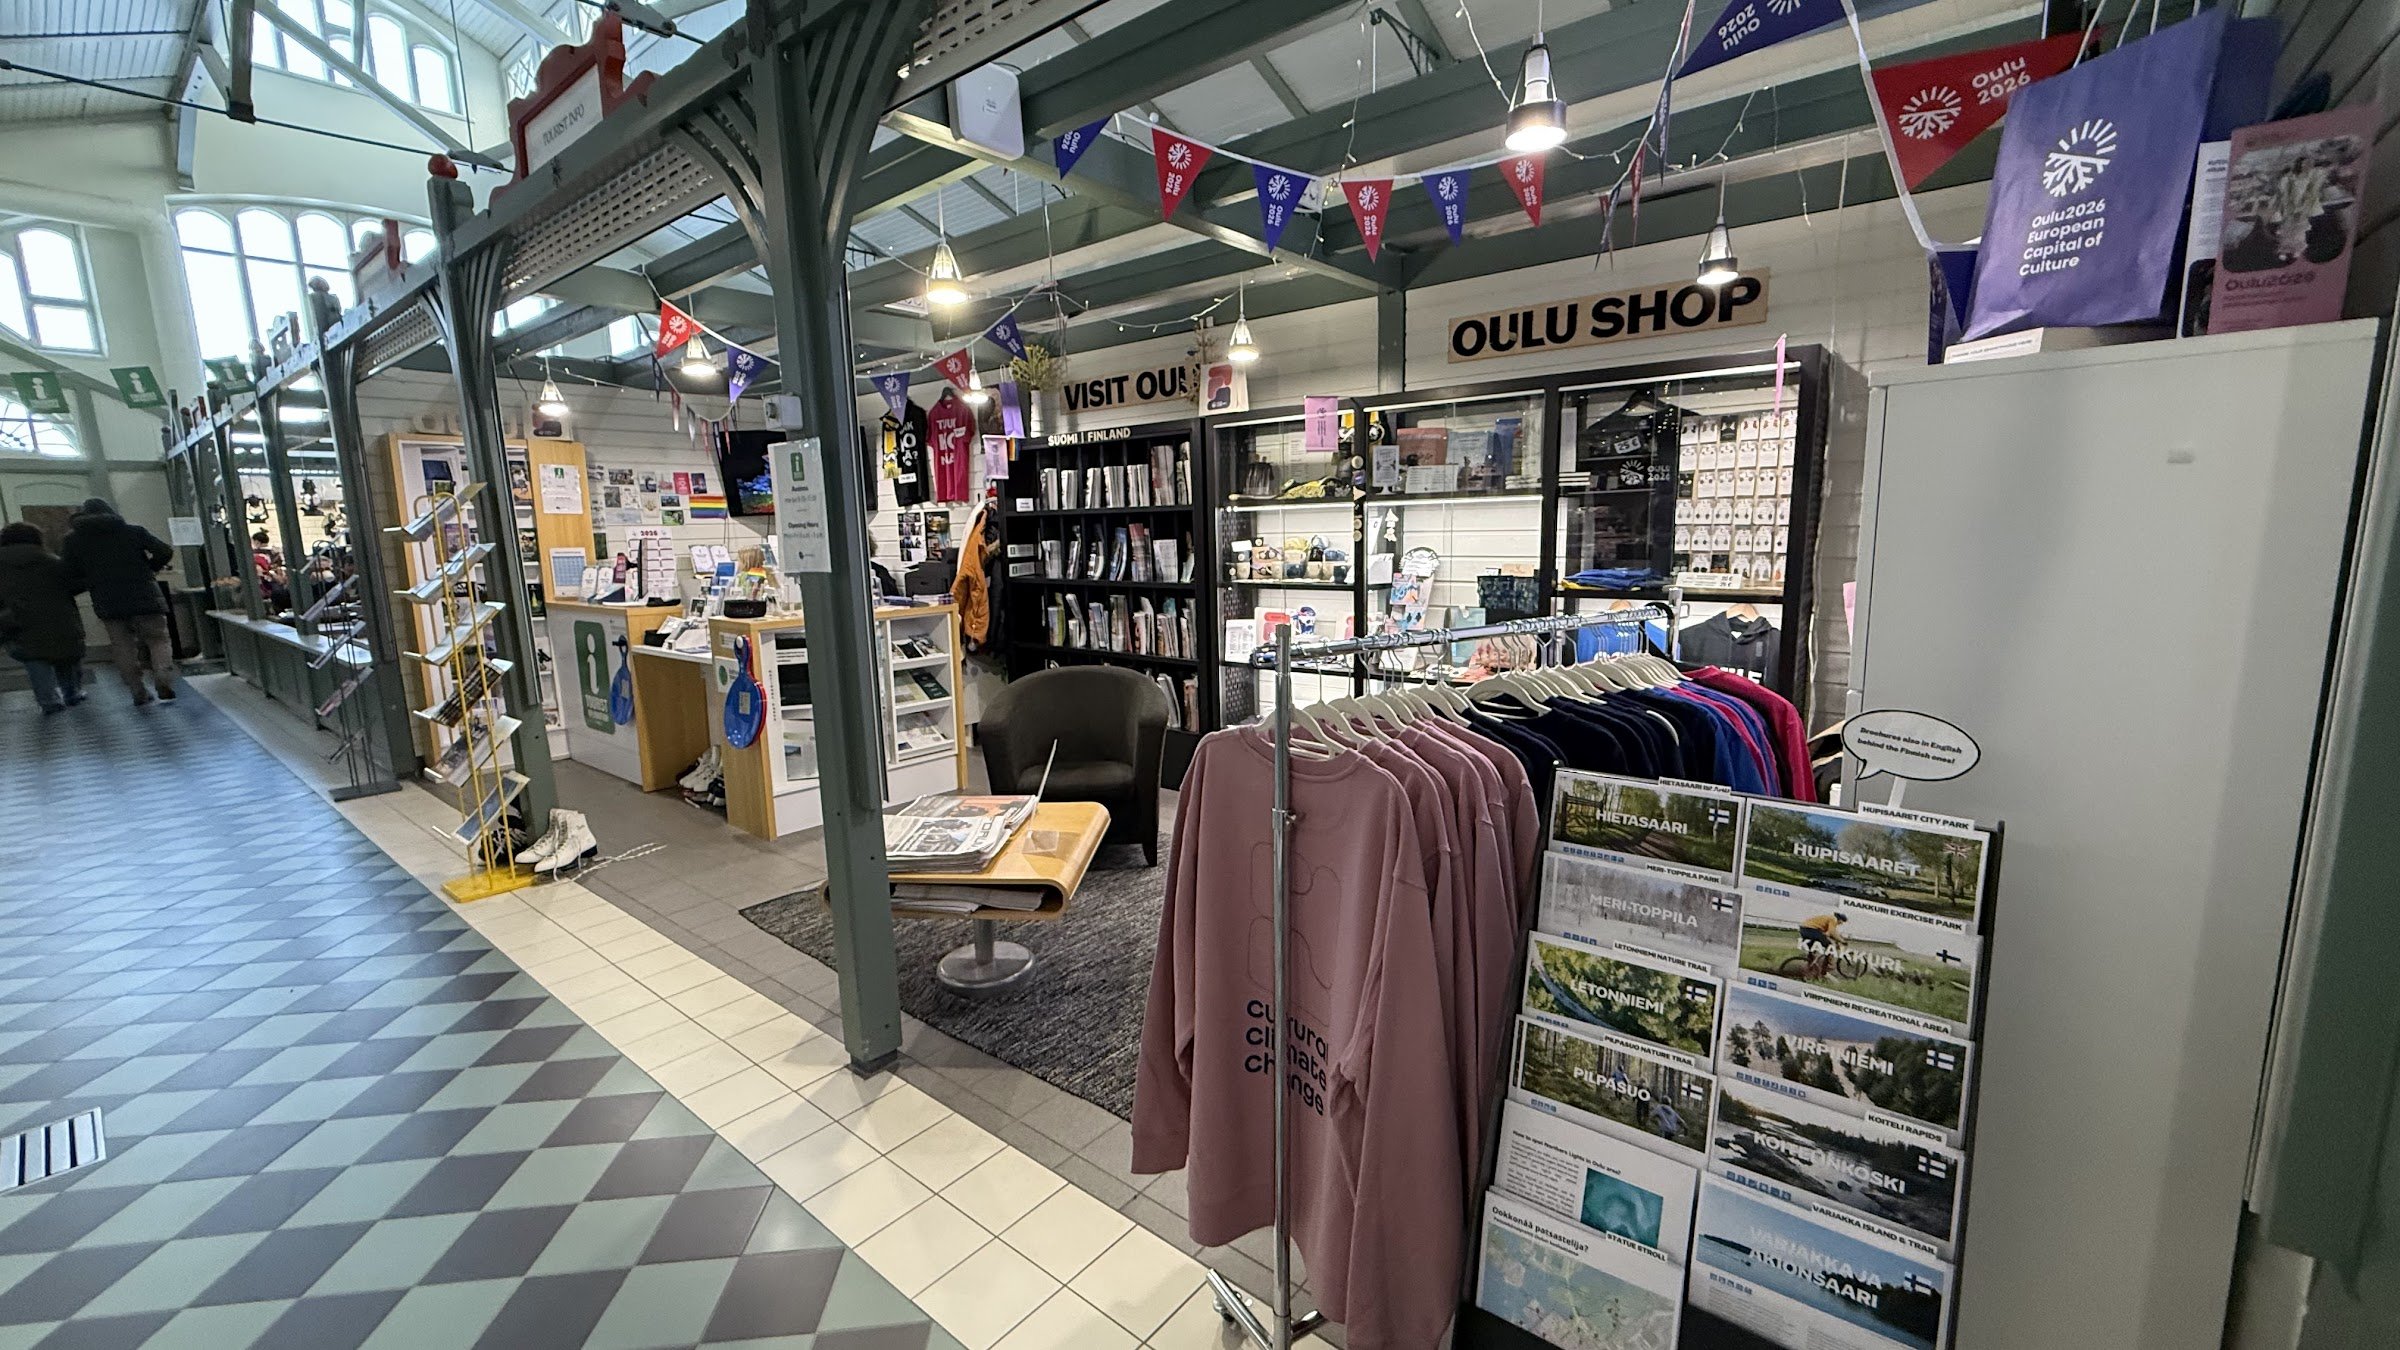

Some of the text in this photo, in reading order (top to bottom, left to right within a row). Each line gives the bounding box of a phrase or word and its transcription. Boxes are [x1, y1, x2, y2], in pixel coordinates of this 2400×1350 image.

[1717, 2, 1756, 39] 2026
[1722, 17, 1761, 51] Oulu
[1971, 56, 2026, 89] Oulu
[1976, 71, 2031, 106] 2026
[1165, 172, 1176, 194] 2026
[1172, 174, 1183, 196] Oulu
[1267, 203, 1276, 226] 2026
[1275, 204, 1284, 227] Oulu
[1370, 214, 1378, 236] Oulu
[2031, 197, 2106, 229] Oulu2026
[2027, 216, 2105, 244] European
[2023, 231, 2104, 260] Capital of
[2019, 255, 2080, 277] Culture
[1452, 276, 1762, 358] OULU SHOP
[1063, 374, 1129, 411] VISIT
[1047, 433, 1078, 447] SUOMI
[1087, 427, 1132, 443] FINLAND
[1857, 737, 1957, 764] behind the Finnish ones!
[1860, 727, 1902, 742] Brochures
[1902, 734, 1921, 745] also
[1930, 740, 1963, 754] English
[1596, 809, 1688, 834] HIETASAARI
[1862, 805, 1970, 830] HUPISAARET CITY PARK
[1646, 864, 1720, 884] MERI-TOPPILA PARK
[1793, 841, 1921, 877] HUPISAARET
[1589, 892, 1699, 928] MERI-TOPPILA
[1843, 898, 1963, 931] KAAKKURI EXERCISE PARK
[1613, 942, 1709, 973] LETONNIEMI NATURE TRAIL
[1569, 978, 1666, 1016] LETONNIEMI
[1803, 990, 1950, 1034] VIRPINIEMI RECREATIONAL AREA
[1604, 1035, 1694, 1067] PILPASUO NATURE TRAIL
[1572, 1065, 1652, 1102] PILPASUO
[1868, 1113, 1943, 1143] KOITELI RAPIDS
[1568, 1150, 1586, 1163] Lights
[1592, 1160, 1607, 1171] Oulu
[1606, 1166, 1622, 1177] area?
[1534, 1224, 1590, 1253] patsastelija?
[1812, 1204, 1862, 1229] VARJAKKA
[1861, 1223, 1899, 1243] ISLAND
[1907, 1241, 1938, 1256] TRAIL
[1607, 1230, 1667, 1262] STATUE STROLL
[1750, 1248, 1880, 1309] AKIONSAARI
[1852, 1266, 1884, 1291] JA
